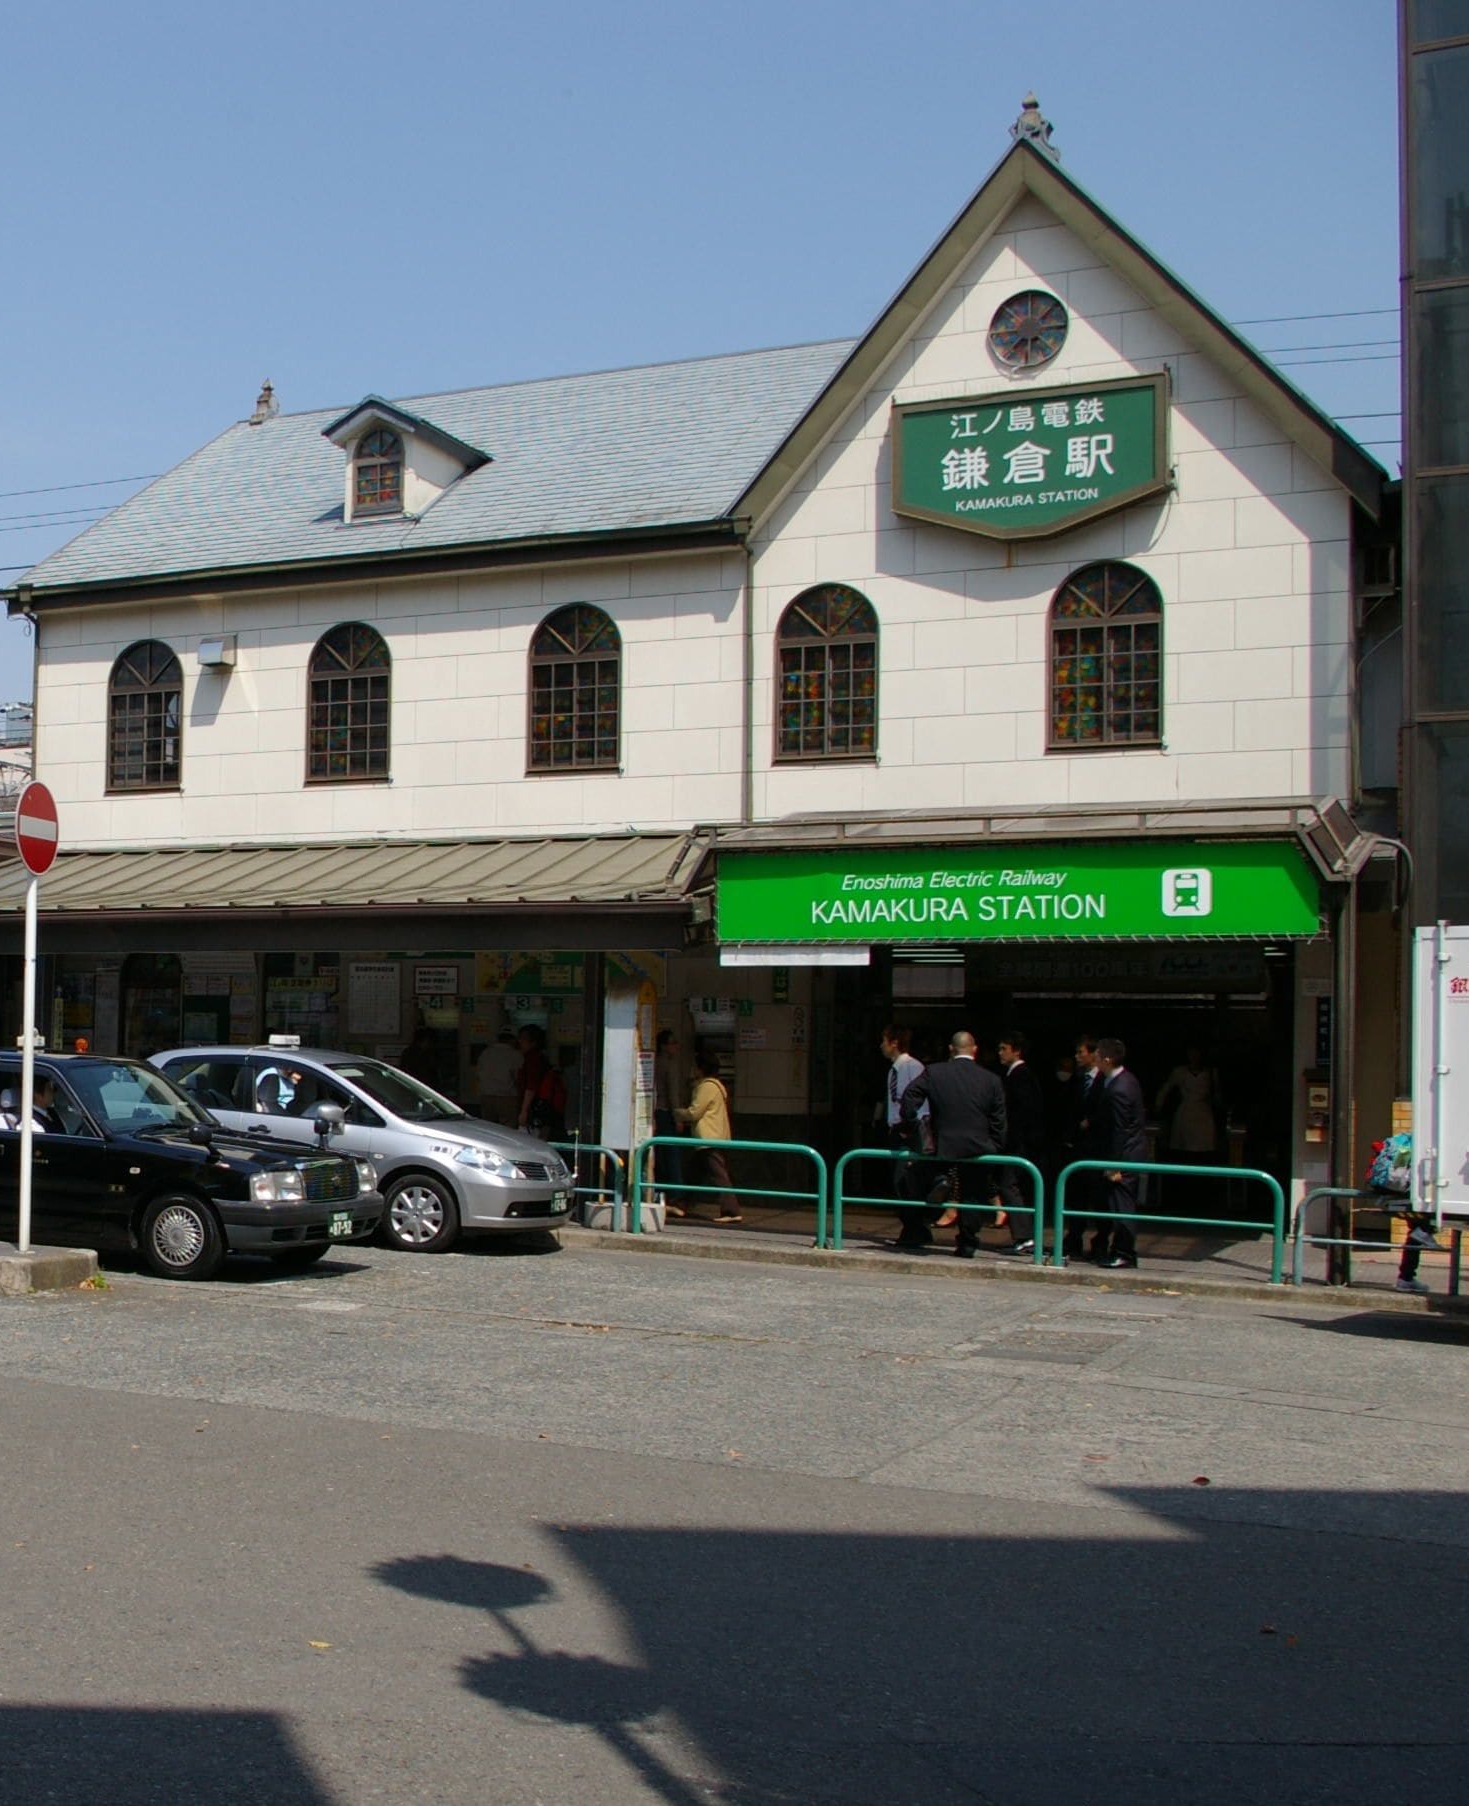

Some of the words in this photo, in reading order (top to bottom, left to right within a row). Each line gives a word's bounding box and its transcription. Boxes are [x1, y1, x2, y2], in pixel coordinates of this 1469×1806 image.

[949, 397, 1105, 440] 江ノ島電鉄
[940, 433, 1115, 491] 鎌倉駅
[955, 495, 1034, 512] KAMAKURA
[1038, 487, 1099, 505] STATION
[842, 874, 923, 891] Enoshima
[929, 870, 992, 889] Electric
[998, 868, 1067, 888] Railway
[811, 897, 969, 924] KAMAKURA
[978, 894, 1106, 921] STATION
